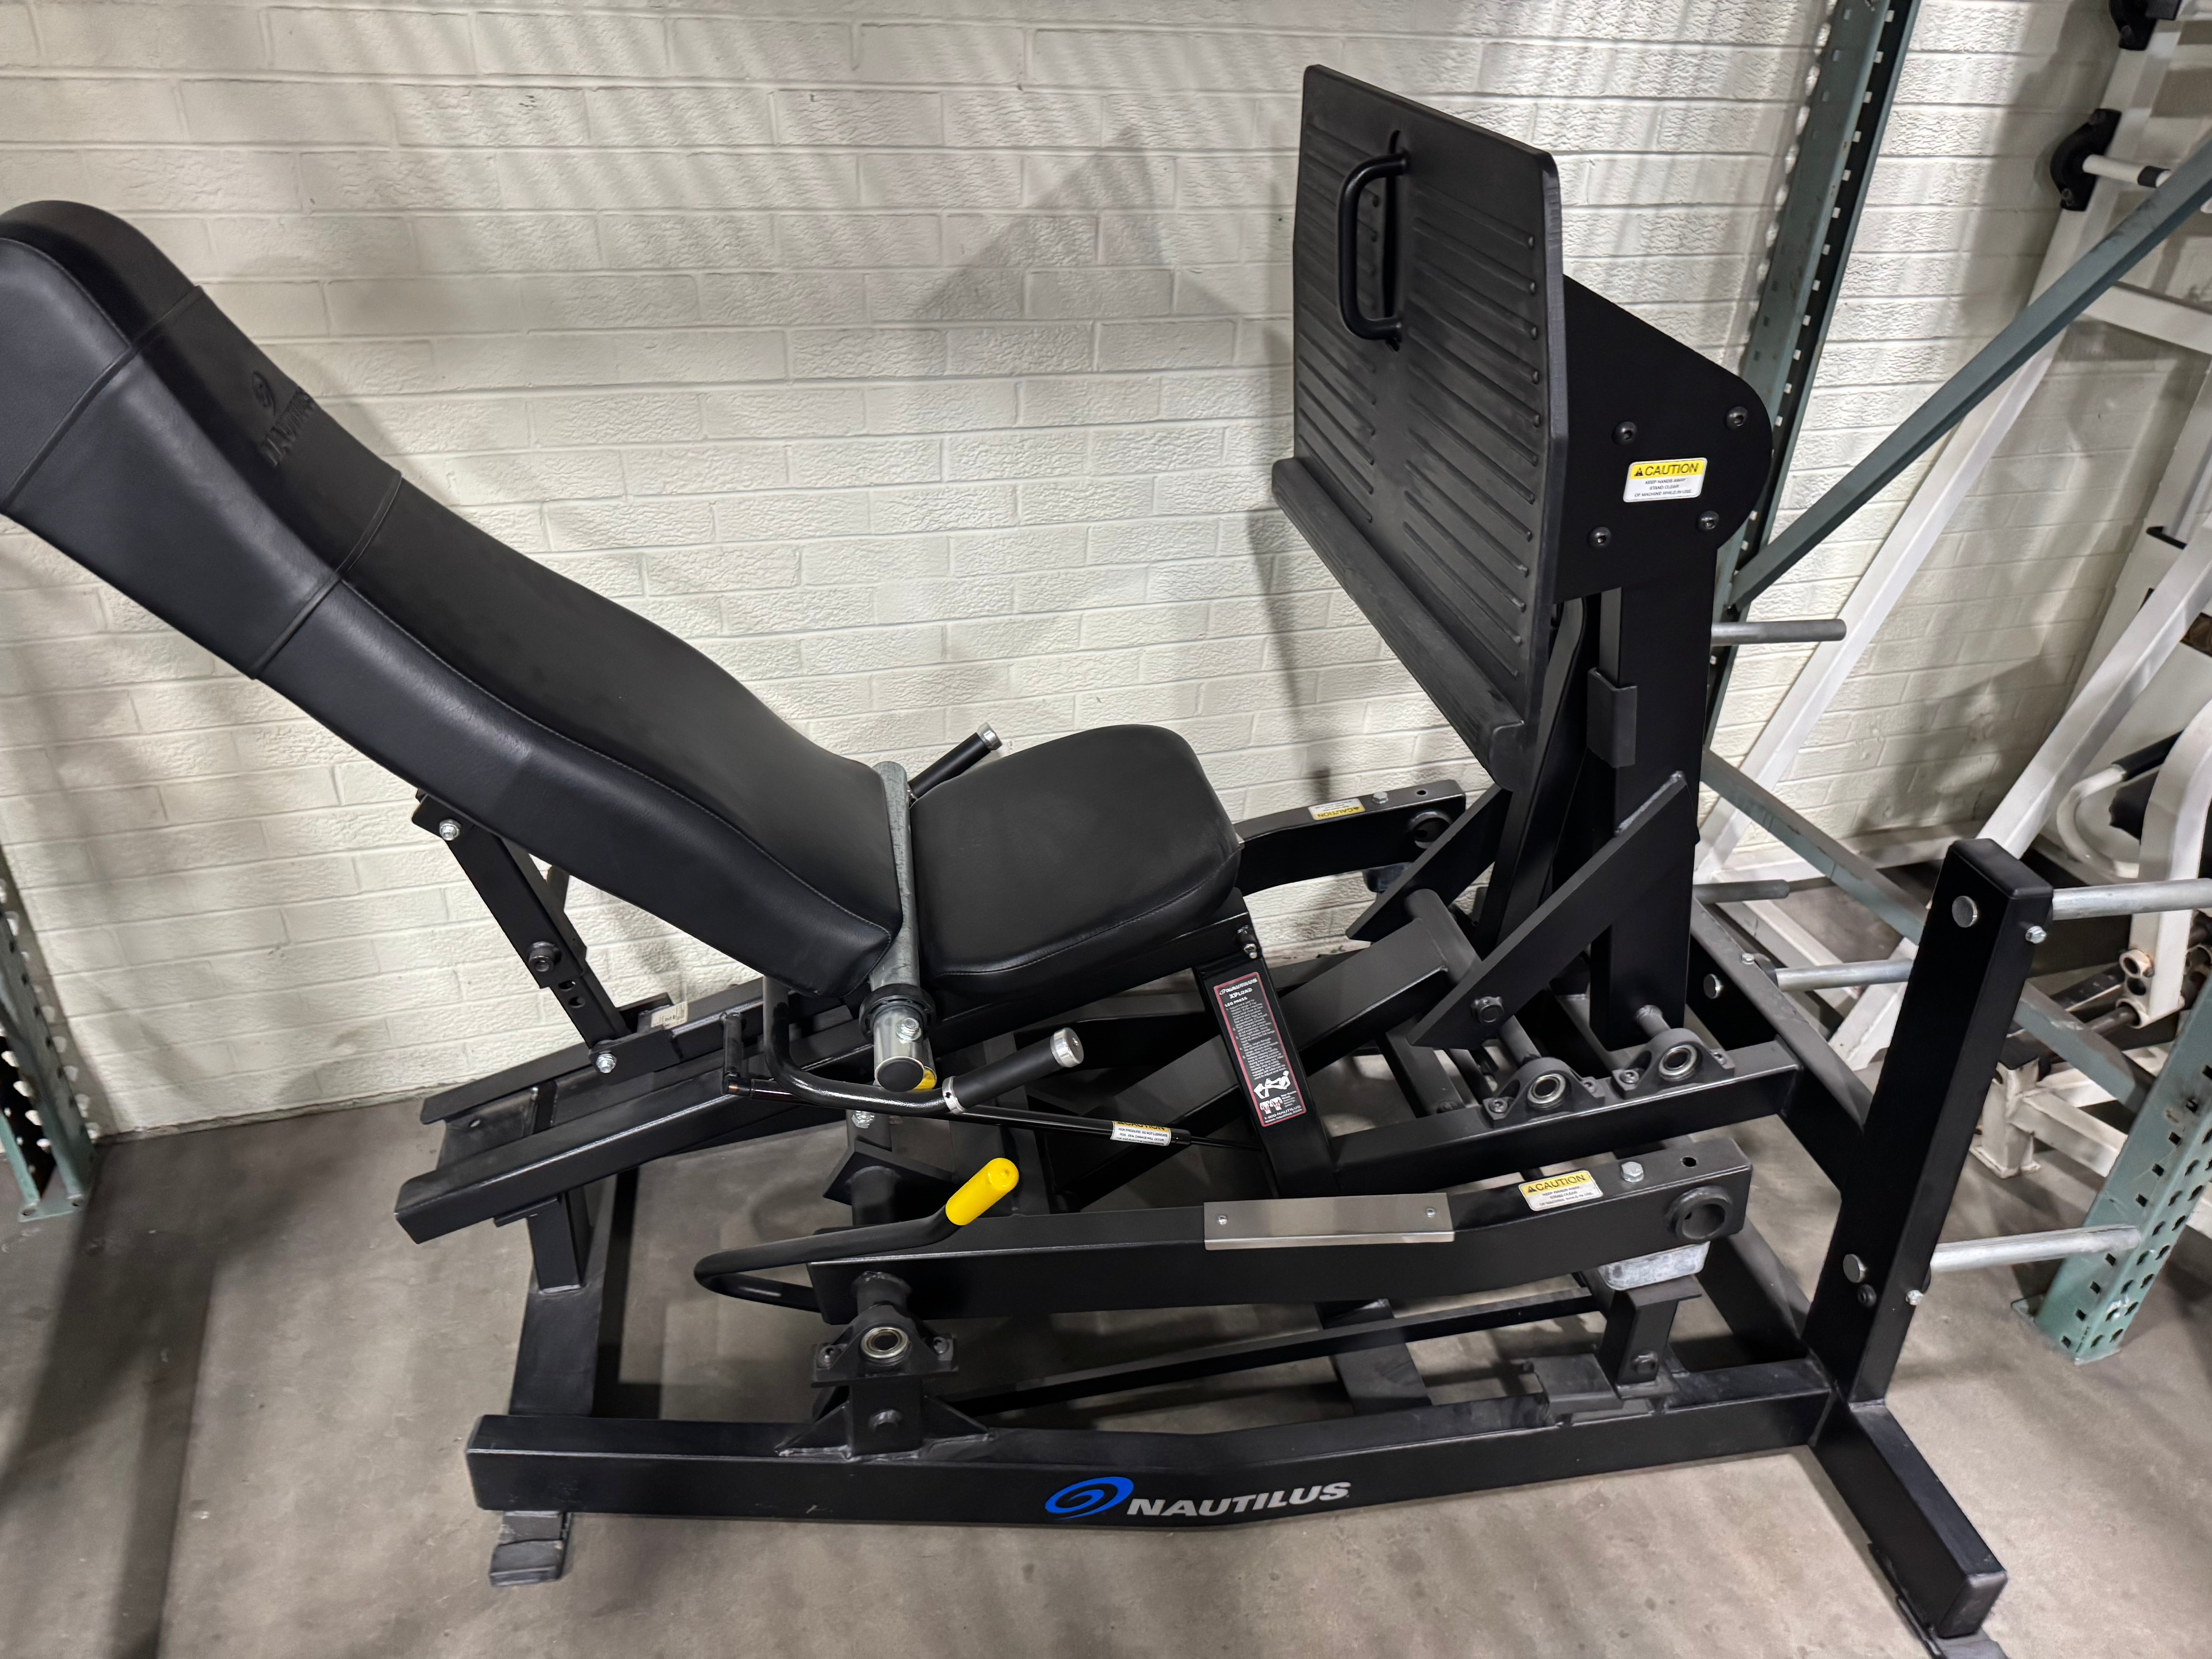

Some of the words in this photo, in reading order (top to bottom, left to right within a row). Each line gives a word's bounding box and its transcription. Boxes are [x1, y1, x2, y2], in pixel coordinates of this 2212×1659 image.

[1645, 463, 1699, 476] CAUTION
[1317, 808, 1353, 817] CAUTION
[1535, 1174, 1586, 1190] CAUTION
[1127, 1482, 1351, 1516] NAUTILUS
